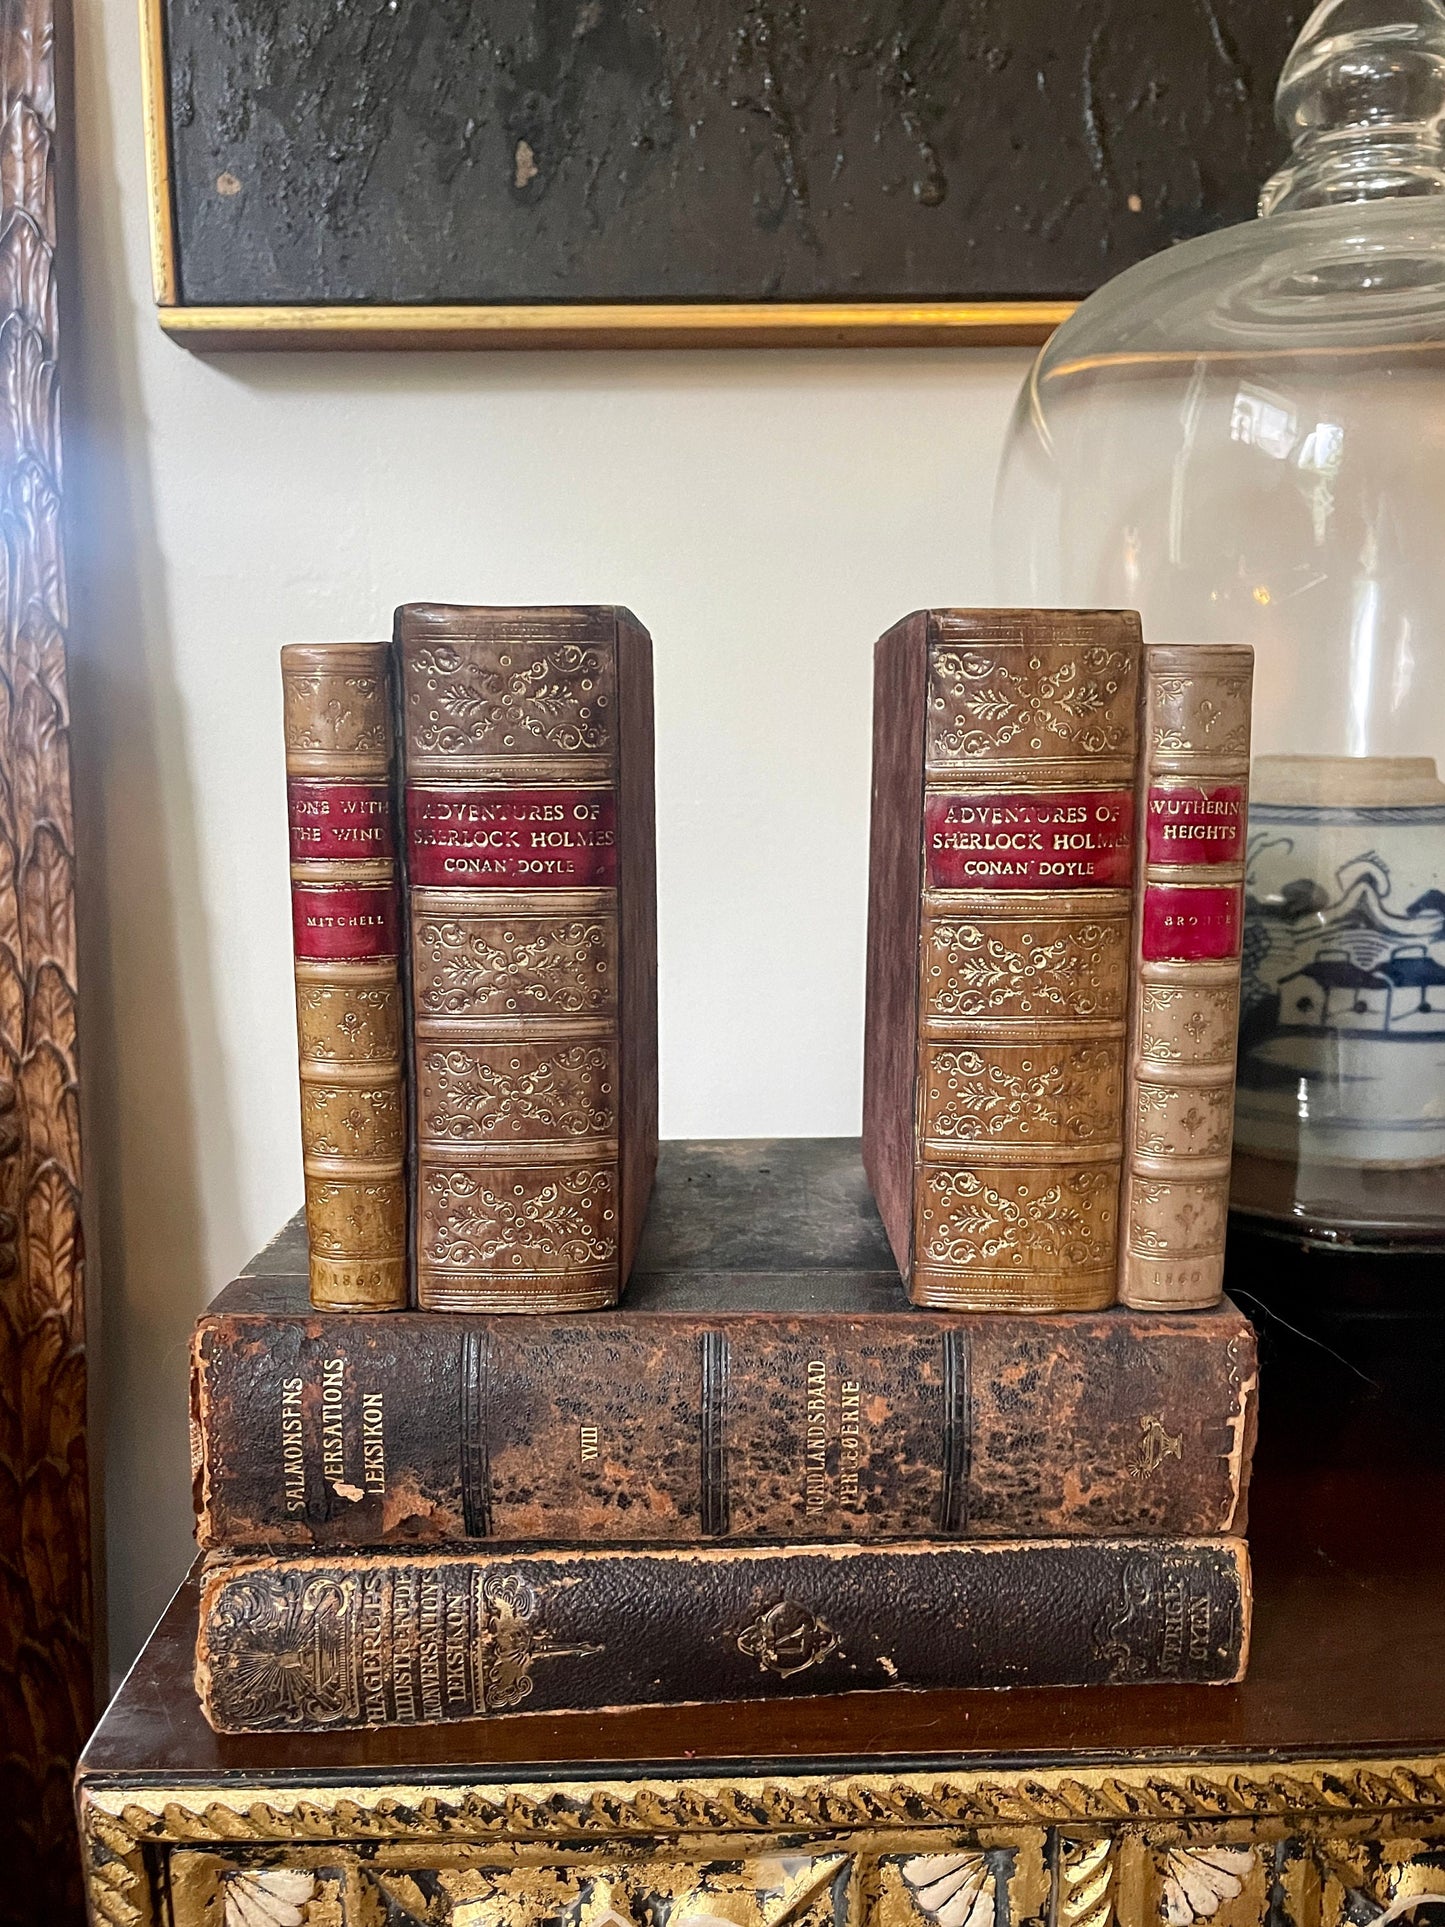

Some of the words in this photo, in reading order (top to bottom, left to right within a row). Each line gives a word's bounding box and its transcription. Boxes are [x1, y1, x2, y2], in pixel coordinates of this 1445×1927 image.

[340, 800, 390, 815] WITH
[422, 803, 564, 821] ADVENTURES
[573, 804, 600, 820] OF
[944, 805, 1087, 824] ADVENTURES
[1095, 806, 1121, 823] OF
[291, 826, 322, 842] THE
[332, 826, 386, 842] WIND
[414, 829, 520, 848] SHERLOCK
[531, 830, 615, 848] HOLMES
[1163, 825, 1237, 840] HEIGHTS
[933, 832, 1044, 851] SHERLOCK
[444, 857, 508, 873] CONAN
[517, 859, 575, 873] DOYLE
[964, 860, 1029, 876] CONAN
[1039, 861, 1095, 876] DOYLE
[306, 915, 385, 928] MITCHELL
[1164, 916, 1233, 926] BROTE
[333, 1272, 382, 1287] 1860
[363, 1392, 386, 1495] LEKSIKON
[580, 1426, 599, 1463] XVIII
[805, 1360, 827, 1516] NORDLANDSBAAD
